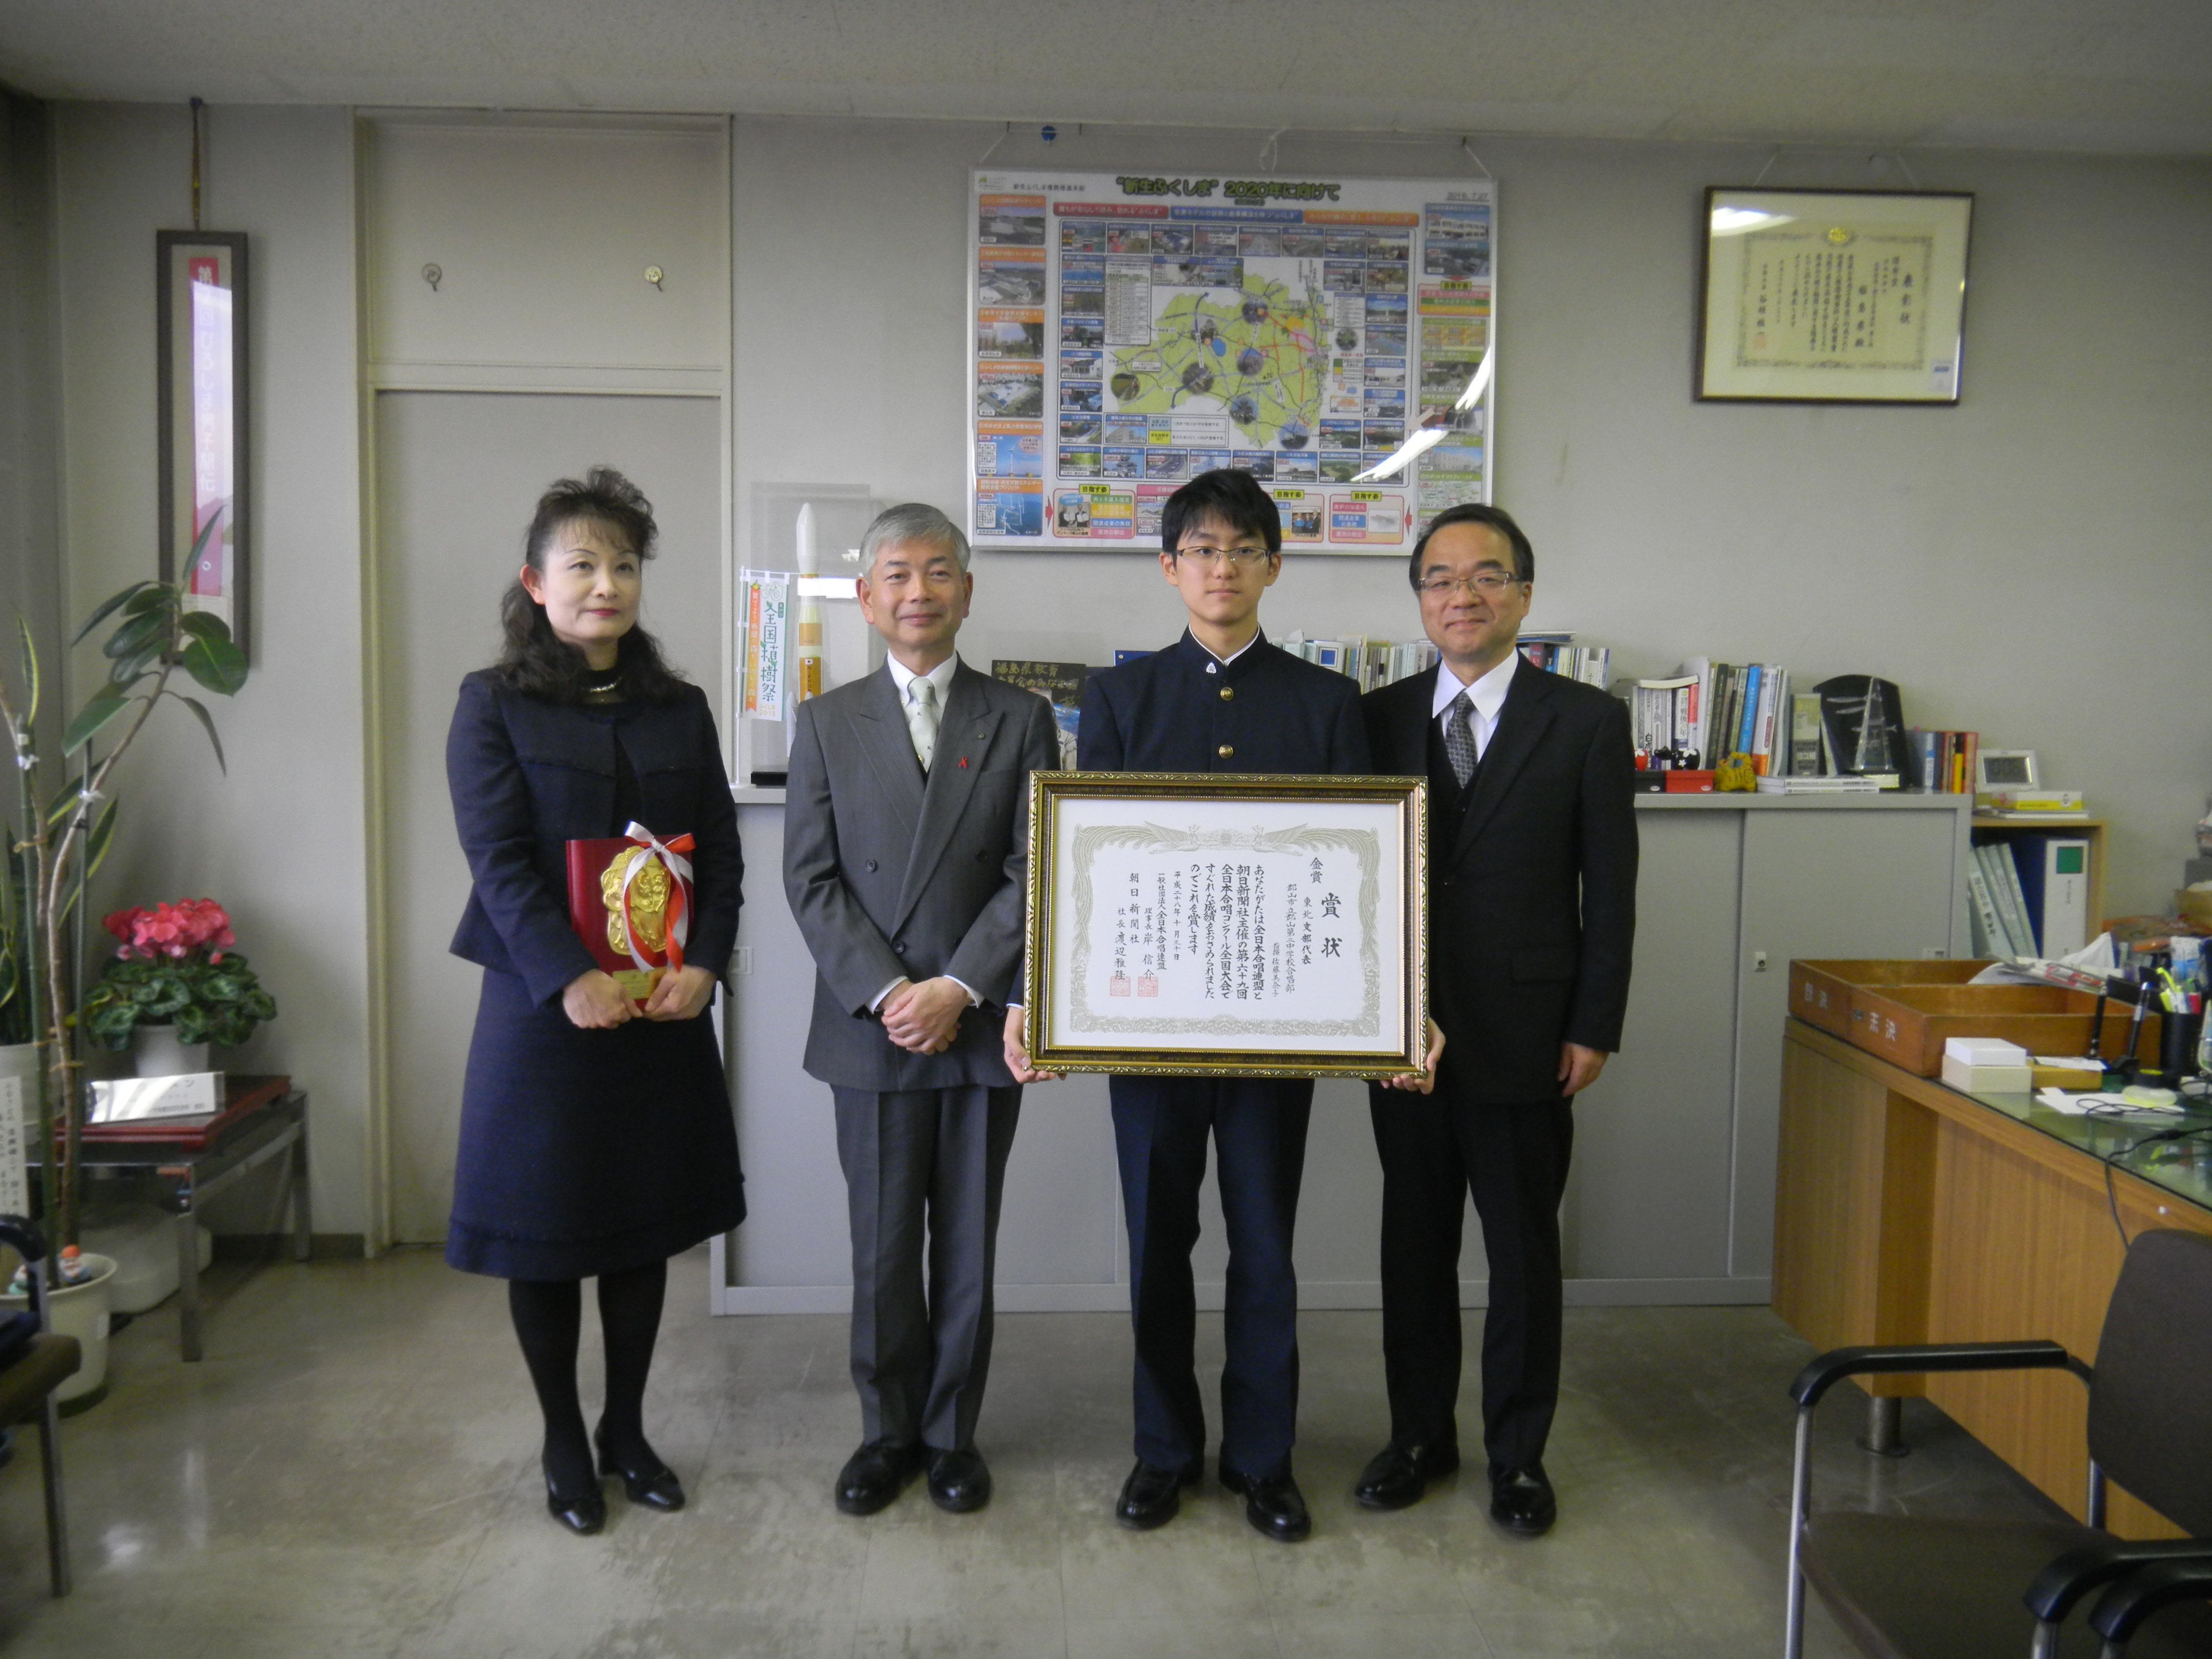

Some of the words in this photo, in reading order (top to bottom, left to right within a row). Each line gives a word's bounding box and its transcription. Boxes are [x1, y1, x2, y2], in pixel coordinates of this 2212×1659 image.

[760, 601, 778, 702] 全国植樹祭
[1116, 907, 1126, 928] 社長
[1129, 873, 1141, 944] 朝日新聞社
[1173, 870, 1182, 961] 平成二十八年十月三十日
[1187, 863, 1202, 955] のでこれを賞します
[1310, 857, 1323, 884] 金賞
[1156, 873, 1167, 971] 一般社団法人全日本合唱連盟
[1203, 863, 1217, 999] すぐれた成績をおさめられました
[1219, 864, 1234, 999] 全日本合唱コンクール全国大会で
[1236, 864, 1250, 1000] 朝日新聞社主催の第六十九回
[1252, 864, 1266, 1000] あなたがたは全日本合唱連盟と
[1285, 883, 1298, 994] 郡山市立郡山第二中学校合唱部
[1301, 896, 1313, 965] 東北支部代表
[1321, 892, 1343, 958] 賞状
